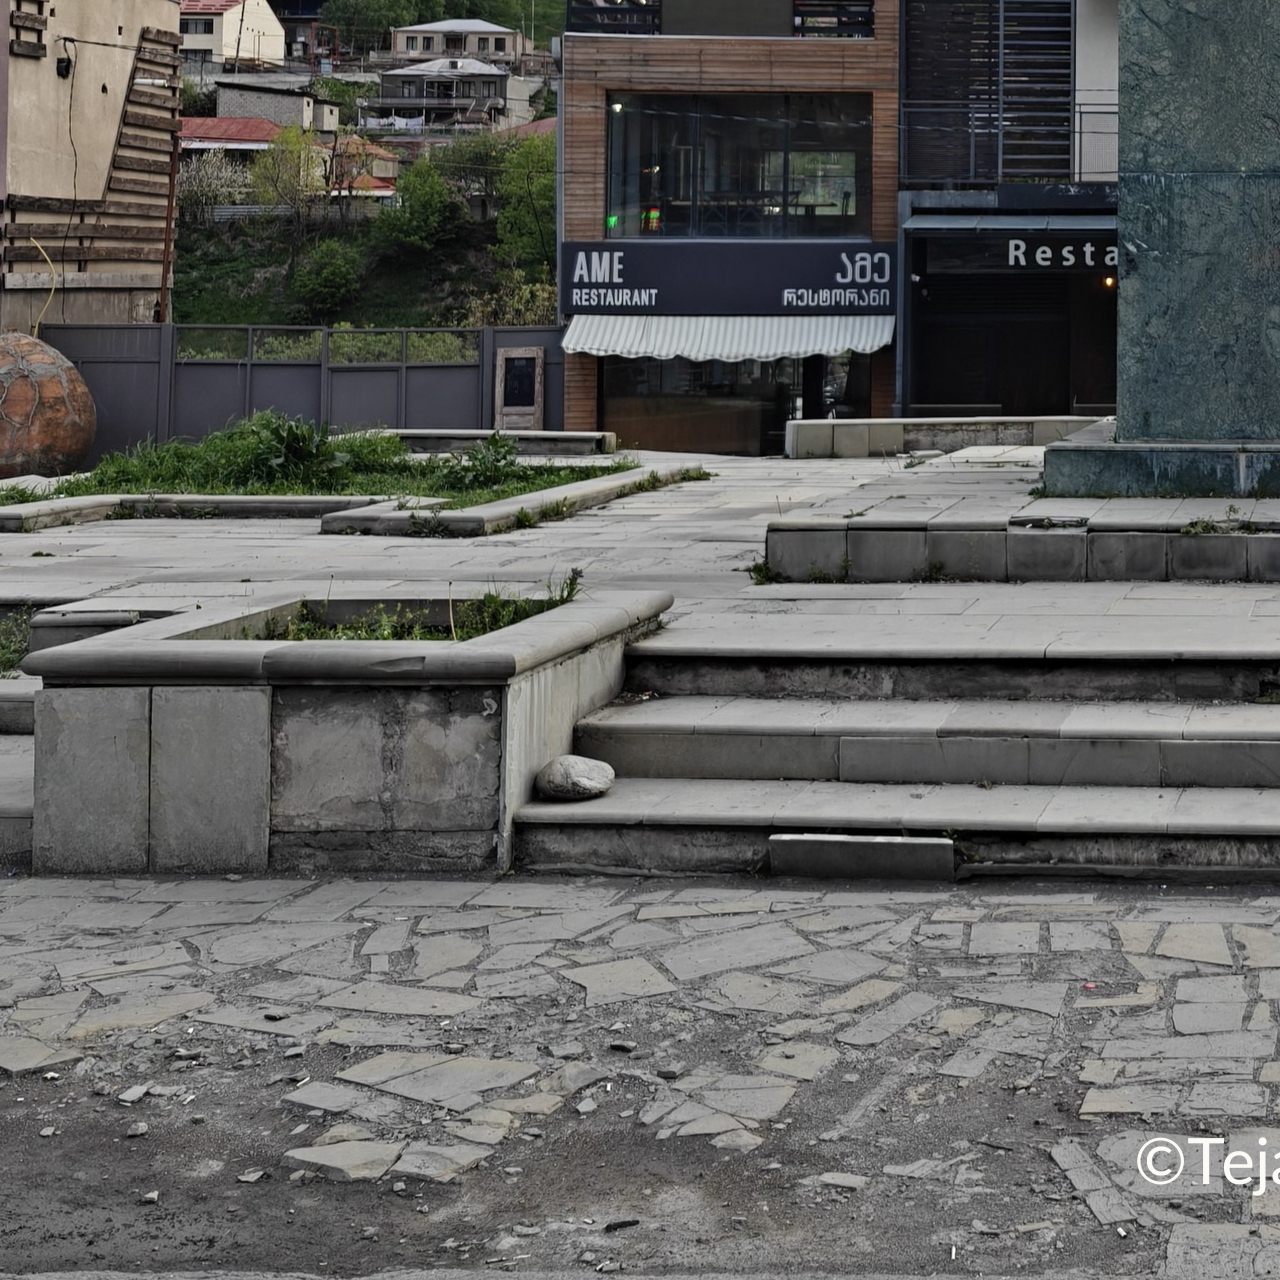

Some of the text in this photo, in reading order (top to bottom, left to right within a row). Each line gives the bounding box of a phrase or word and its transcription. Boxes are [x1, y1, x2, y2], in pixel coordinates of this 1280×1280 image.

[573, 251, 625, 284] AME
[836, 252, 890, 283] ამე
[572, 288, 658, 307] RESTAURANT
[783, 288, 890, 307] რესტორანი
